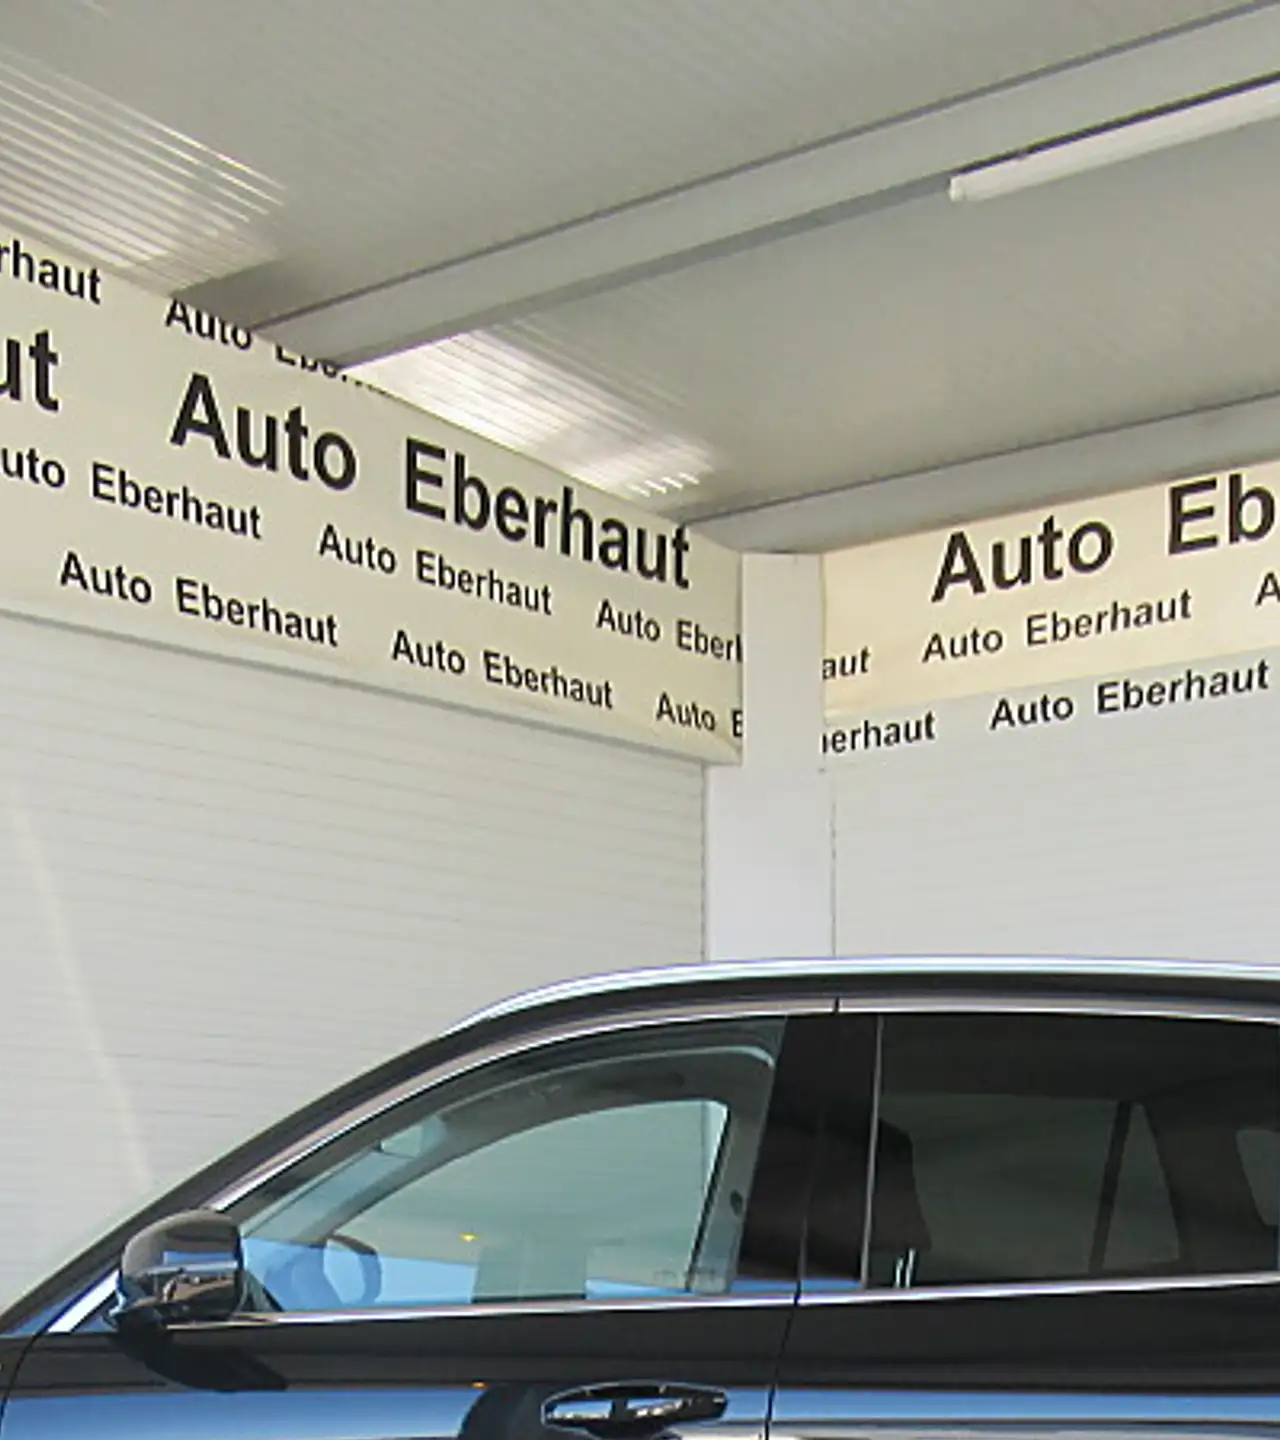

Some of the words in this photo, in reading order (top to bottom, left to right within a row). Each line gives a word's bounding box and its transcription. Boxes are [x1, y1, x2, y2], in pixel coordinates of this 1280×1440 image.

[92, 461, 261, 540] Eberhaut
[169, 372, 357, 491] Auto
[405, 437, 690, 589] Eberhaut
[319, 523, 396, 575] Auto
[416, 549, 552, 616] Eberhaut
[931, 515, 1113, 603] Auto
[60, 551, 152, 604] Auto
[175, 577, 338, 648] Eberhaut
[596, 598, 661, 642] Auto
[922, 628, 1003, 663] Auto
[1026, 589, 1191, 646] Eberhaut
[391, 629, 466, 675] Auto
[483, 649, 613, 710] Eberhaut
[990, 694, 1074, 731] Auto
[1097, 659, 1269, 714] Eberhaut
[656, 691, 717, 732] Auto
[821, 711, 936, 755] erhaut
